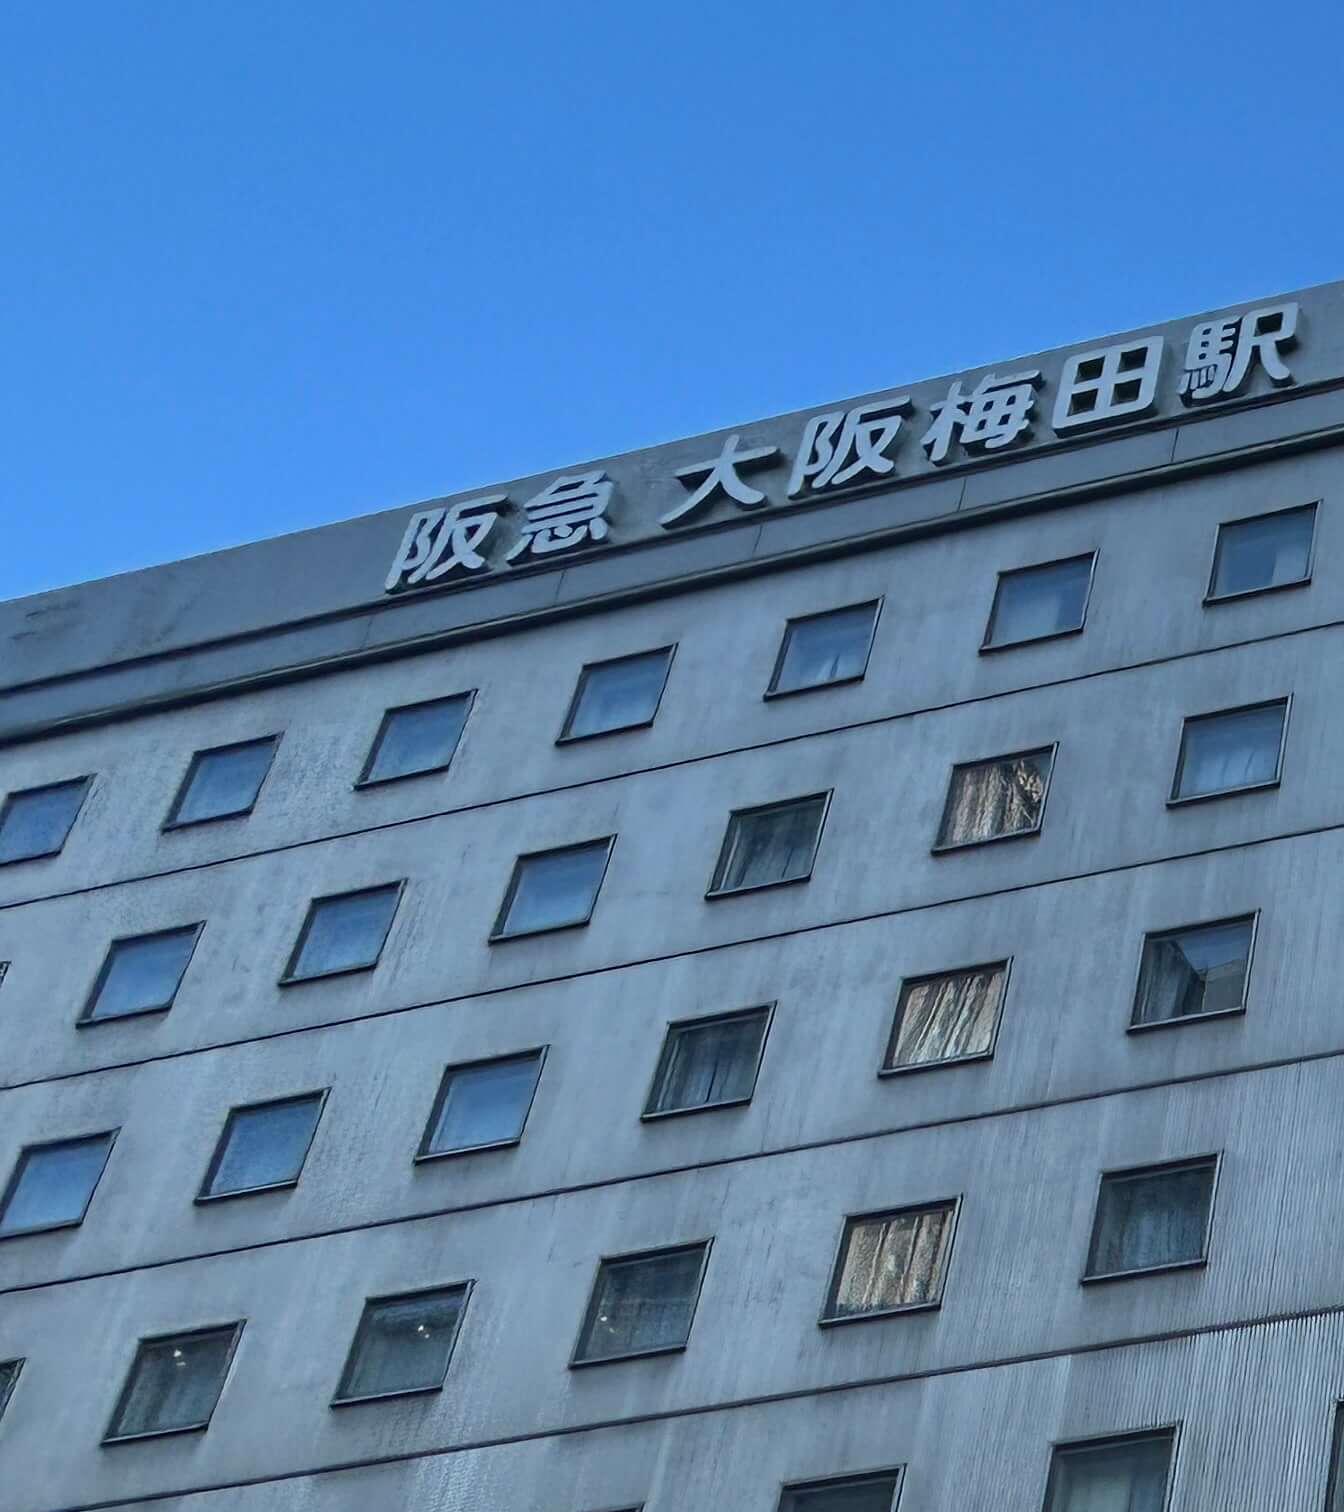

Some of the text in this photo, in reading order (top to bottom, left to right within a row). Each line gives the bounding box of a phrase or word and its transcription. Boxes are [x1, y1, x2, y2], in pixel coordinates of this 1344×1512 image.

[384, 301, 1302, 598] 阪急 大阪梅田駅
